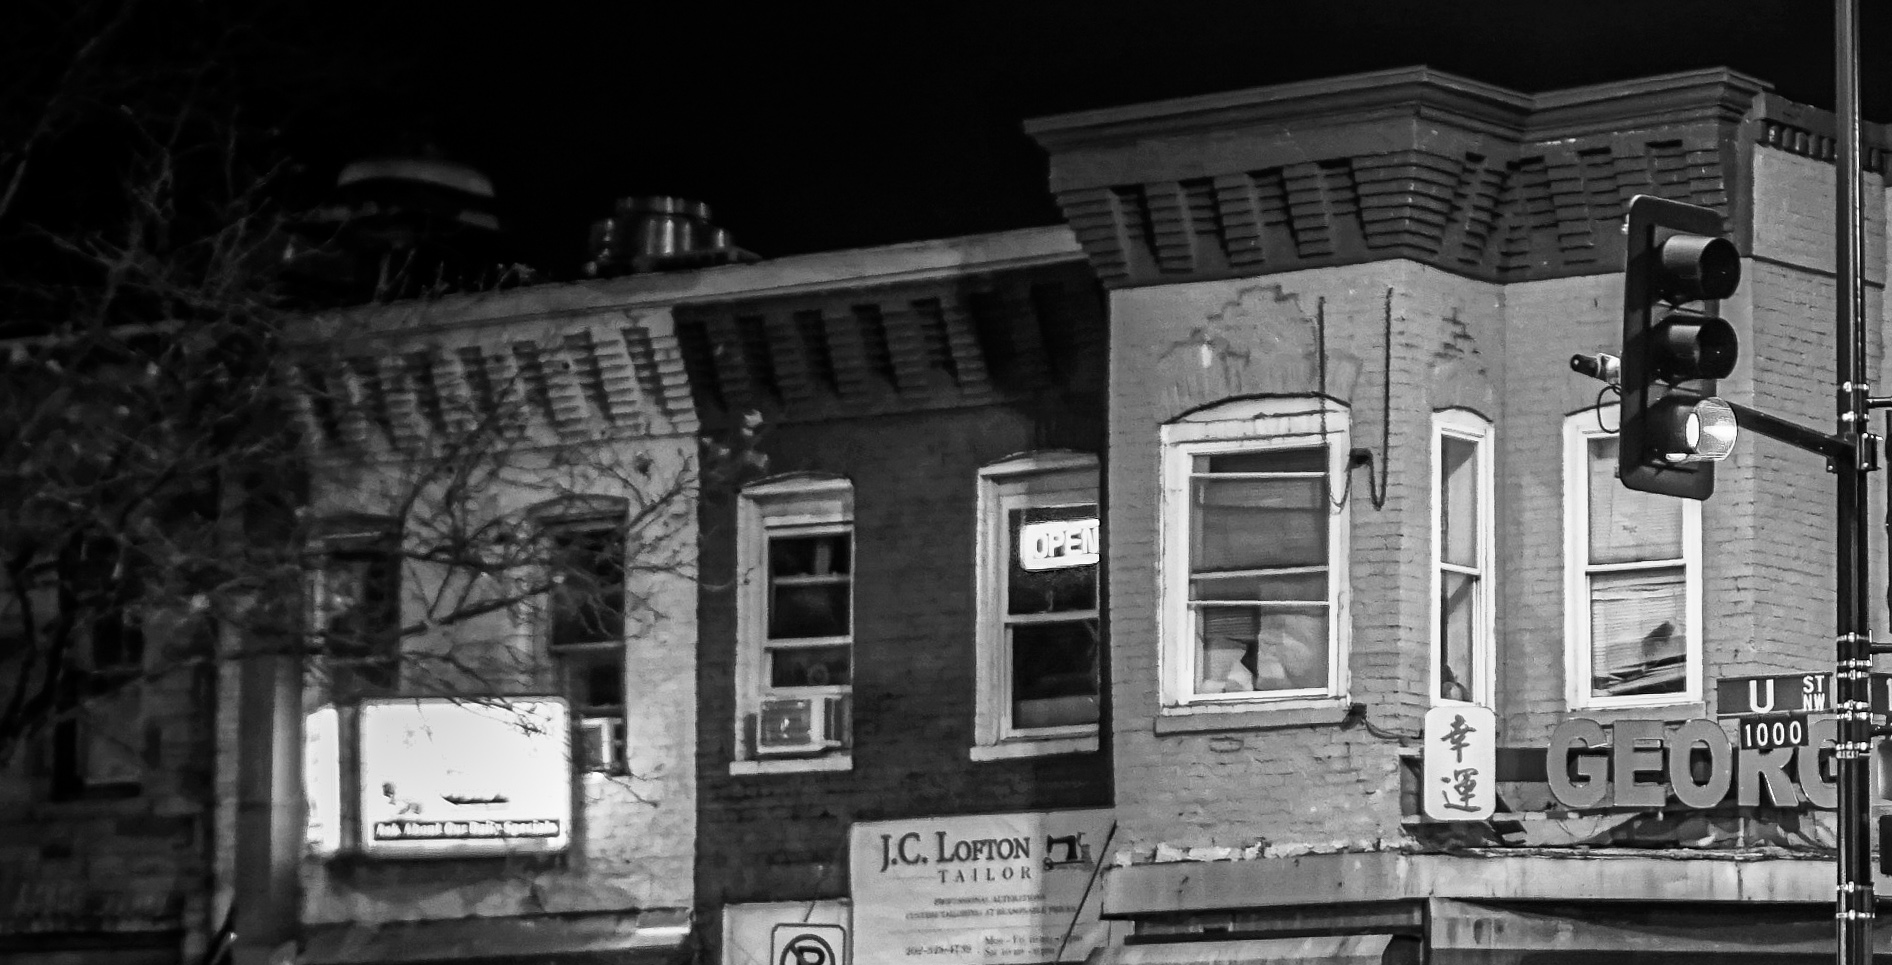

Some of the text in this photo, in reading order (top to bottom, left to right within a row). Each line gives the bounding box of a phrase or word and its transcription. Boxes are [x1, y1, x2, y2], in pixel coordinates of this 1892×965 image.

[1031, 527, 1099, 559] OPEN
[1749, 675, 1825, 714] U ST
[1802, 694, 1826, 711] NW
[1744, 720, 1802, 748] 1000
[1440, 713, 1481, 813] 幸運
[879, 832, 929, 873] J.C.
[937, 866, 1033, 884] TAILOR
